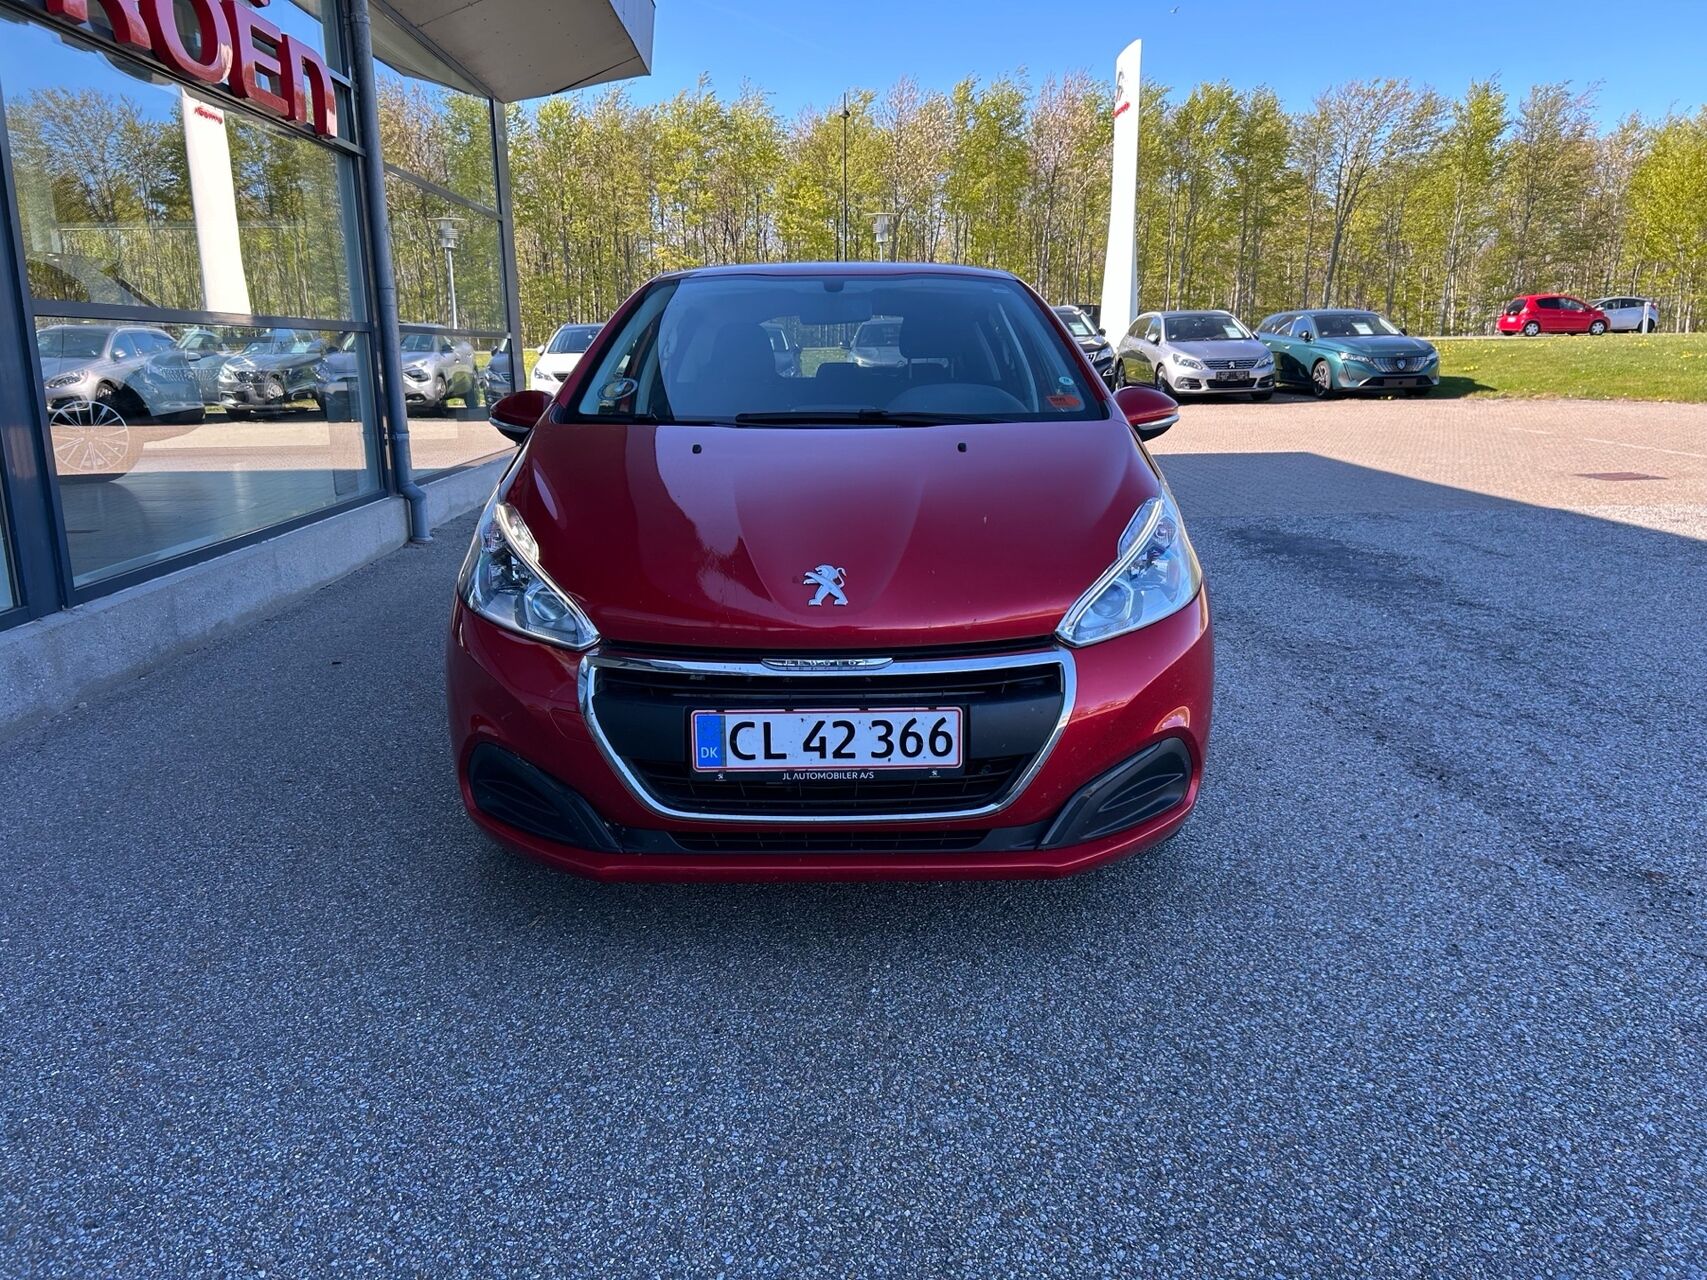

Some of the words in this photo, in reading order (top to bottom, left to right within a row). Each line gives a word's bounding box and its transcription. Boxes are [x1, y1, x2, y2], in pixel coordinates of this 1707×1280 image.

[729, 721, 788, 761] CL
[802, 720, 857, 760] 42
[870, 717, 954, 759] 366
[700, 746, 718, 759] DK
[782, 772, 791, 781] JL
[792, 771, 858, 781] AUTOMOBILER
[859, 770, 875, 780] A/S
